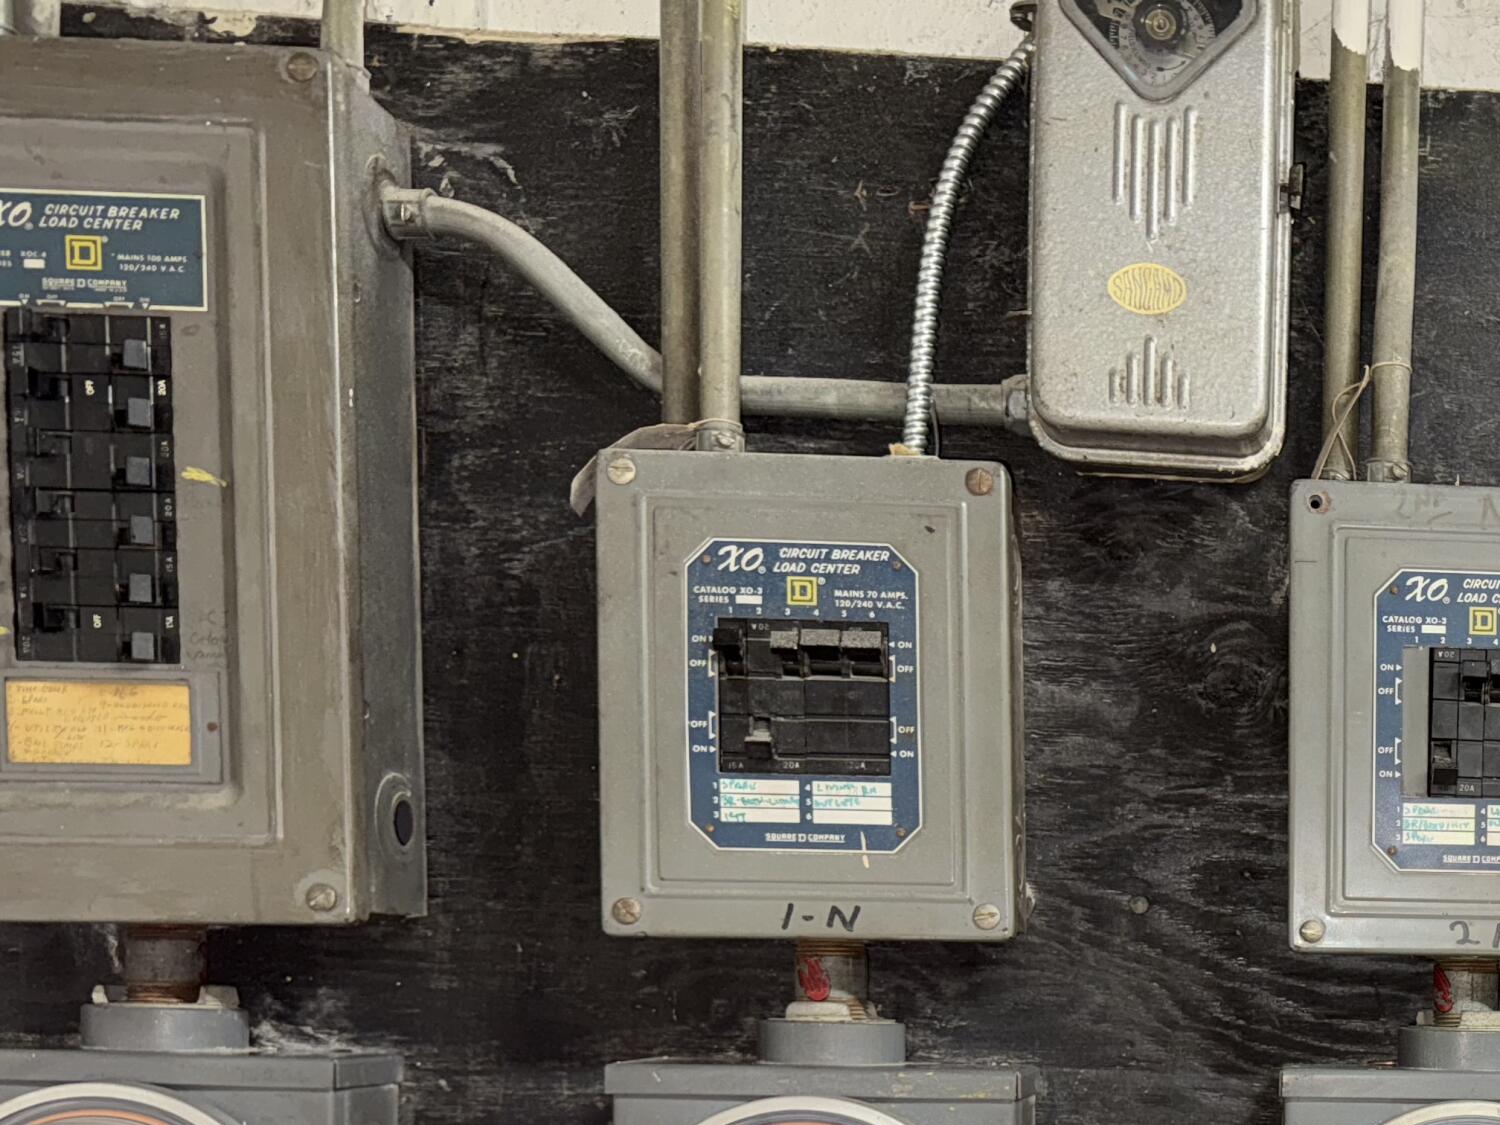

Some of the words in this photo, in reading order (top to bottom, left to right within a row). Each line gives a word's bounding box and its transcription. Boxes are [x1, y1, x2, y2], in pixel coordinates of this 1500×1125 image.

[44, 203, 105, 216] CIRCUIT
[107, 206, 180, 220] BREAKER
[38, 216, 79, 228] LOAD
[83, 217, 143, 231] CENTER
[117, 254, 144, 262] MAINS
[119, 263, 157, 272] 120/240
[164, 498, 172, 517] 20A
[717, 545, 763, 572] XO
[778, 547, 830, 559] CIRCUIT
[831, 548, 890, 562] BREAKER
[772, 562, 806, 574] LOAD
[810, 562, 861, 575] CENTER
[693, 586, 737, 594] CATALOG
[1405, 576, 1449, 601] XO
[833, 589, 865, 598] MAINS
[866, 591, 878, 599] 70
[1456, 593, 1488, 603] LOAD
[698, 595, 730, 604] SERIES
[834, 600, 873, 609] 120/240
[877, 601, 905, 610] V.A.C.
[1382, 615, 1422, 624] CATALOG
[1387, 625, 1416, 633] SERIES
[691, 635, 707, 643] ON
[897, 641, 913, 649] ON
[689, 659, 707, 668] OFF
[897, 665, 914, 673] OFF
[1378, 687, 1394, 695] OFF
[690, 720, 708, 728] OFF
[1459, 784, 1475, 792] 20A
[765, 832, 796, 842] SQUARE
[808, 834, 845, 843] COMPANY
[1443, 854, 1471, 863] SQUARE
